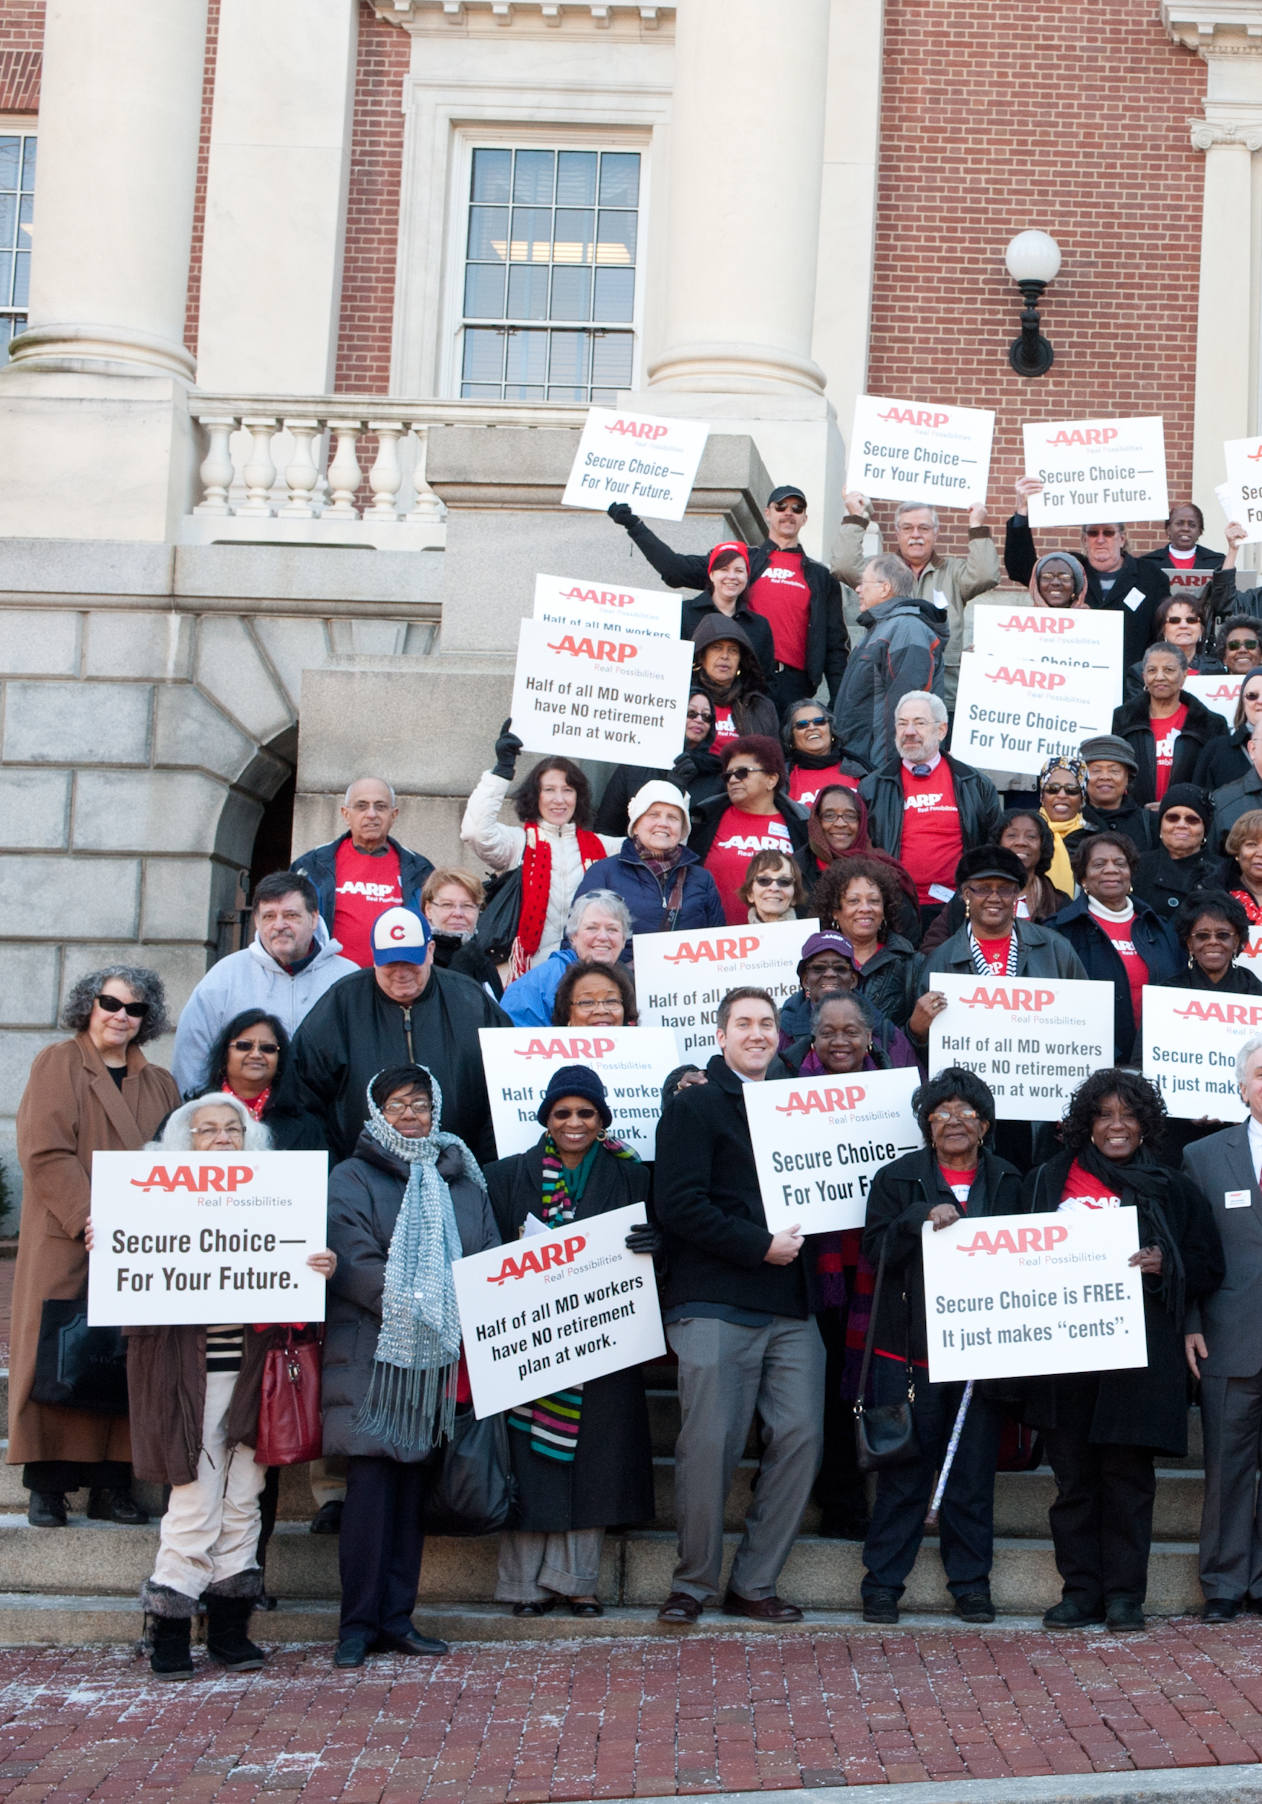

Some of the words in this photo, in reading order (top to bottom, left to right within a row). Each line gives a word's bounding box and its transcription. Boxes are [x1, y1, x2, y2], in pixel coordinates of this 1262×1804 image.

[603, 418, 668, 440] AARP
[876, 406, 949, 428] AARP
[1045, 427, 1118, 447] AARP
[583, 451, 626, 471] Secure
[862, 440, 909, 460] Secure
[579, 473, 601, 489] For
[604, 476, 630, 493] Your
[631, 480, 673, 500] Future.
[863, 462, 886, 479] For
[890, 465, 920, 483] Your
[922, 469, 970, 489] Future.
[1037, 468, 1085, 484] Secure
[1042, 491, 1065, 506] For
[1068, 489, 1099, 505] Your
[1102, 487, 1151, 503] Future.
[546, 634, 638, 663] AARP
[594, 663, 613, 672] Real
[615, 666, 665, 680] Possibilities
[984, 666, 1066, 690] AARP
[525, 676, 554, 693] Half
[557, 681, 572, 695] of
[575, 683, 593, 698] all
[596, 685, 619, 701] MD
[623, 692, 677, 710] workers
[533, 697, 566, 715] have
[570, 702, 589, 717] NO
[592, 707, 664, 728] retirement
[969, 704, 1021, 726] Secure
[551, 721, 582, 737] plan
[585, 725, 600, 739] at
[603, 729, 641, 744] work.
[335, 881, 392, 897] AARP
[390, 925, 406, 941] C
[663, 936, 760, 965] AARP
[717, 964, 737, 973] Real
[739, 959, 794, 971] Possibilities
[959, 986, 1055, 1011] AARP
[942, 1035, 971, 1051] Half
[975, 1037, 990, 1051] of
[994, 1037, 1012, 1052] all
[1017, 1038, 1040, 1053] MD
[1044, 1040, 1103, 1057] workers
[774, 1084, 866, 1117] AARP
[771, 1150, 833, 1173] Secure
[129, 1165, 253, 1192] AARP
[198, 1196, 221, 1206] Real
[226, 1196, 292, 1206] Possibilities
[111, 1229, 191, 1254] Secure
[956, 1225, 1068, 1257] AARP
[486, 1235, 586, 1286] AARP
[116, 1267, 154, 1292] For
[161, 1267, 211, 1291] Your
[219, 1266, 298, 1290] Future.
[475, 1316, 507, 1342] Half
[511, 1310, 526, 1329] of
[531, 1302, 551, 1323] all
[554, 1293, 579, 1315] MD
[583, 1275, 643, 1305] workers
[935, 1295, 994, 1314] Secure
[999, 1288, 1057, 1310] Choice
[1063, 1286, 1078, 1305] is
[1083, 1282, 1132, 1303] FREE.
[491, 1338, 528, 1362] have
[531, 1326, 552, 1348] NO
[556, 1299, 636, 1339] retirement
[517, 1355, 551, 1381] plan
[555, 1346, 571, 1365] at
[573, 1332, 616, 1357] work.
